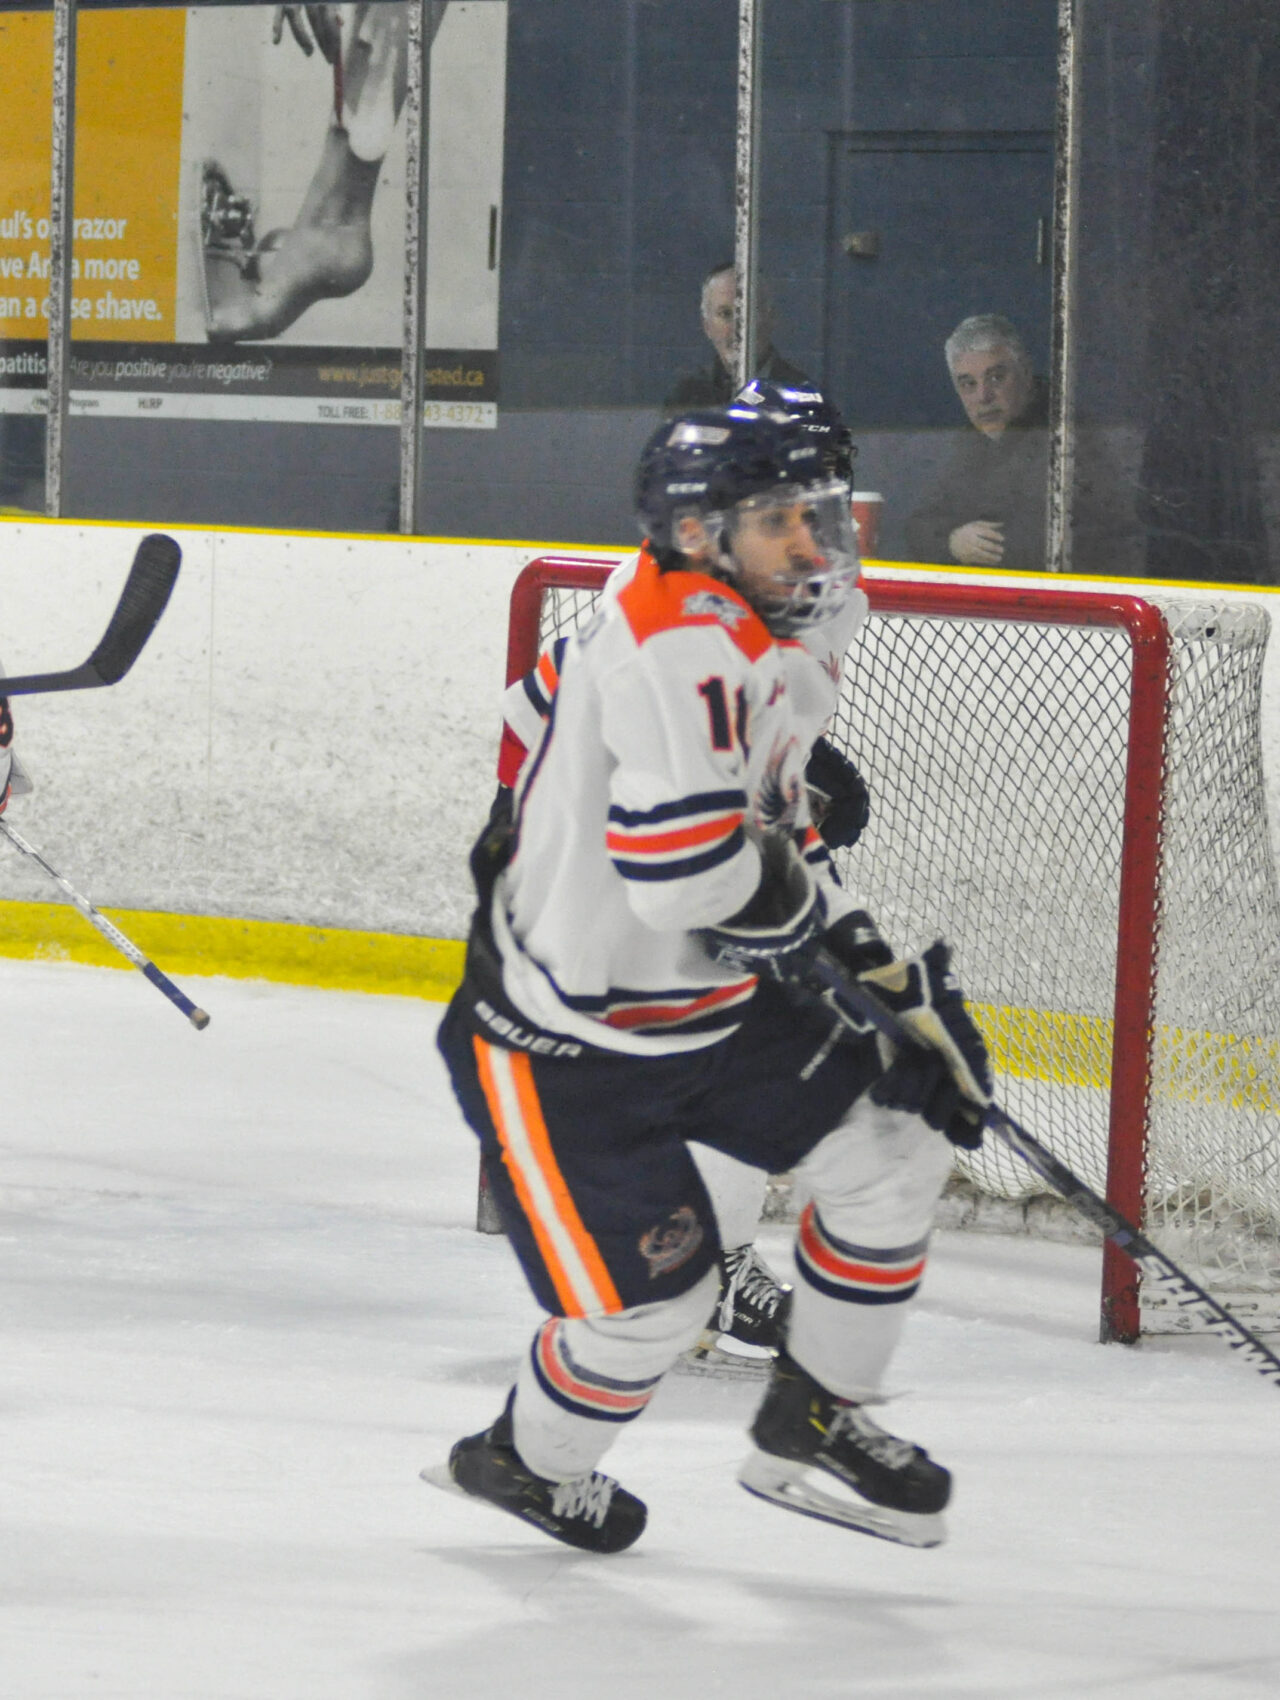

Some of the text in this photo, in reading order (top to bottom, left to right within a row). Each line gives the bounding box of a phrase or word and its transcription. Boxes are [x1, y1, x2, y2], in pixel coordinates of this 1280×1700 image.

[84, 258, 140, 280] more
[25, 297, 37, 319] a
[96, 291, 163, 321] shave.
[115, 357, 167, 381] positive
[318, 405, 341, 419] TOLL
